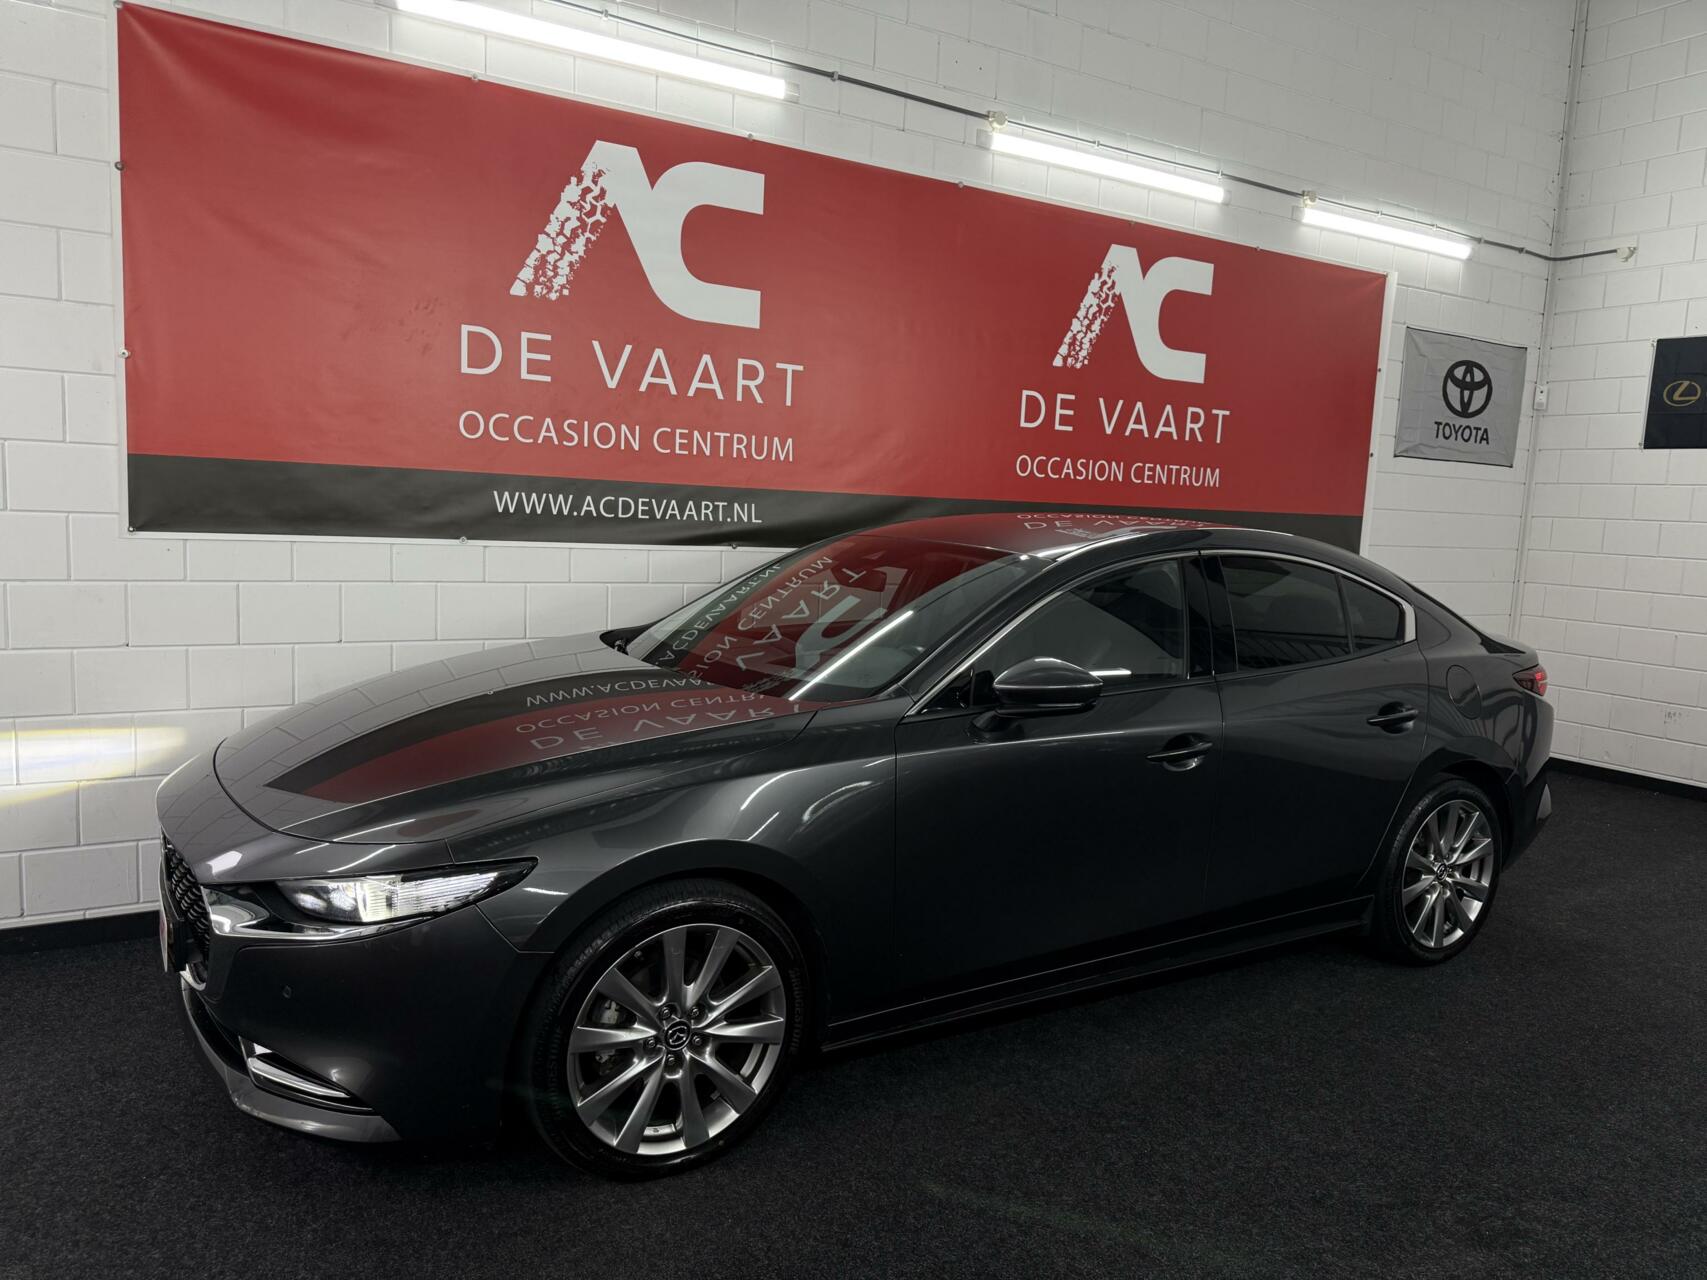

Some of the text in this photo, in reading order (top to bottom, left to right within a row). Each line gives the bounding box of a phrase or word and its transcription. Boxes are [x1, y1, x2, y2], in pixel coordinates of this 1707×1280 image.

[509, 139, 765, 329] AC
[1052, 243, 1215, 384] AC
[460, 324, 804, 406] DE VAART
[458, 410, 794, 462] OCCASION CENTRUM
[1019, 389, 1231, 444] DE VAART
[1434, 421, 1490, 445] TOYOTA
[1016, 454, 1220, 487] OCCASION CENTRUM
[493, 490, 762, 523] WWW.ACDEVAART.NL
